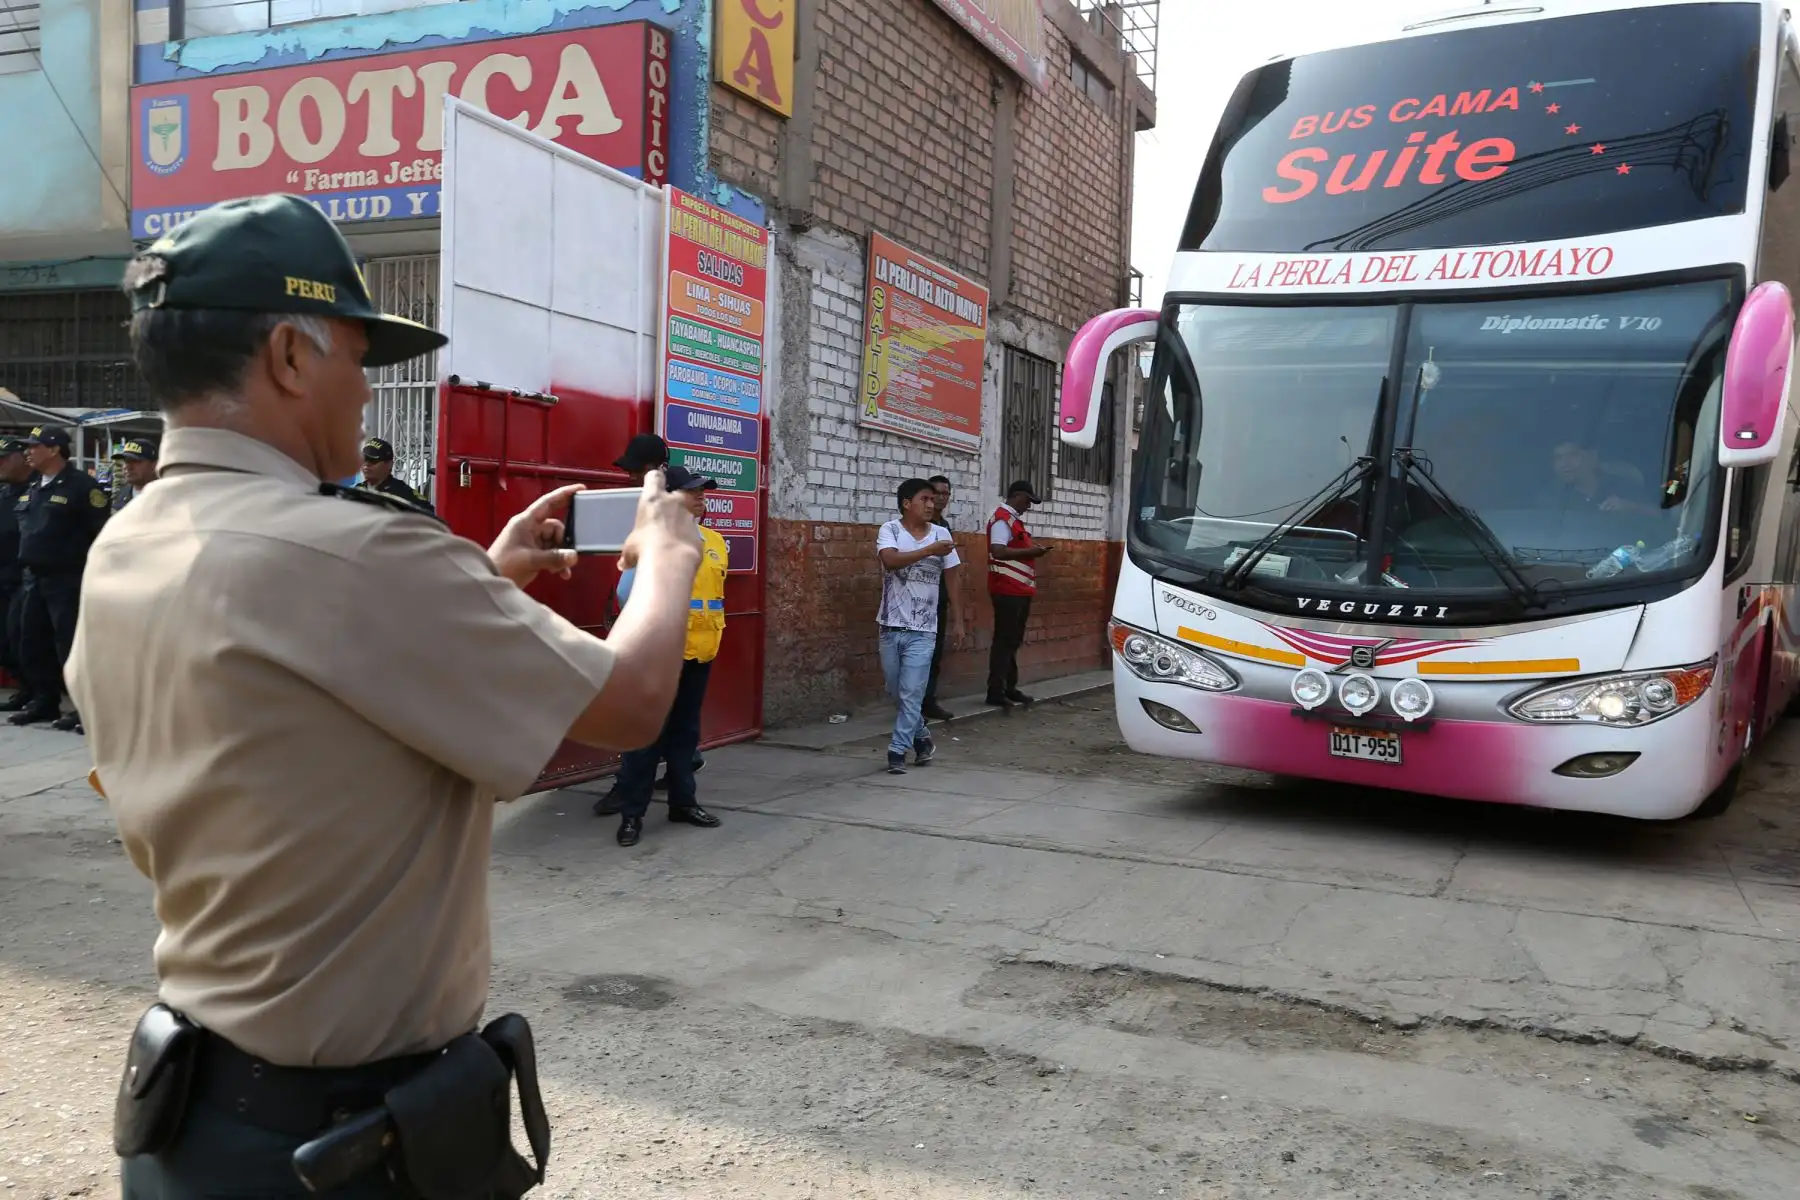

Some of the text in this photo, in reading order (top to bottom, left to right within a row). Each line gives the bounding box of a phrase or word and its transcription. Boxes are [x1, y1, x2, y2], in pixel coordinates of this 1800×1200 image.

[212, 43, 623, 171] BOTICA
[1288, 87, 1520, 140] BUS CAMA
[384, 158, 443, 185] Jeffe
[1262, 130, 1516, 204] Suite
[313, 192, 430, 223] ALUD Y
[670, 207, 682, 234] LA
[683, 212, 709, 246] PERLA
[709, 223, 723, 252] DEL
[698, 250, 744, 287] SALIDAS
[1226, 263, 1260, 289] LA
[1264, 258, 1351, 288] PERLA
[1358, 255, 1418, 284] DEL
[284, 276, 336, 304] PERU
[686, 281, 752, 317] LIMA SIHUAS
[874, 255, 888, 283] LA
[888, 262, 917, 296] PERLA
[917, 276, 934, 304] DEL
[934, 283, 956, 314] ALTO
[955, 293, 979, 324] MAYO
[670, 320, 761, 358] TAYABAMBA HUANCASPATA
[1479, 314, 1663, 333] Diplomatic V10
[864, 286, 887, 419] SALIDA
[668, 364, 709, 388] PAROBAMBA
[687, 411, 743, 435] QUINUABAMBA
[704, 434, 724, 445] LUNES
[684, 455, 743, 475] HUACRACHUCO
[704, 498, 733, 513] RONGO
[1161, 590, 1217, 621] VOLVO
[1295, 597, 1449, 619] VEGUZTI
[1333, 733, 1397, 758] D1T-955
